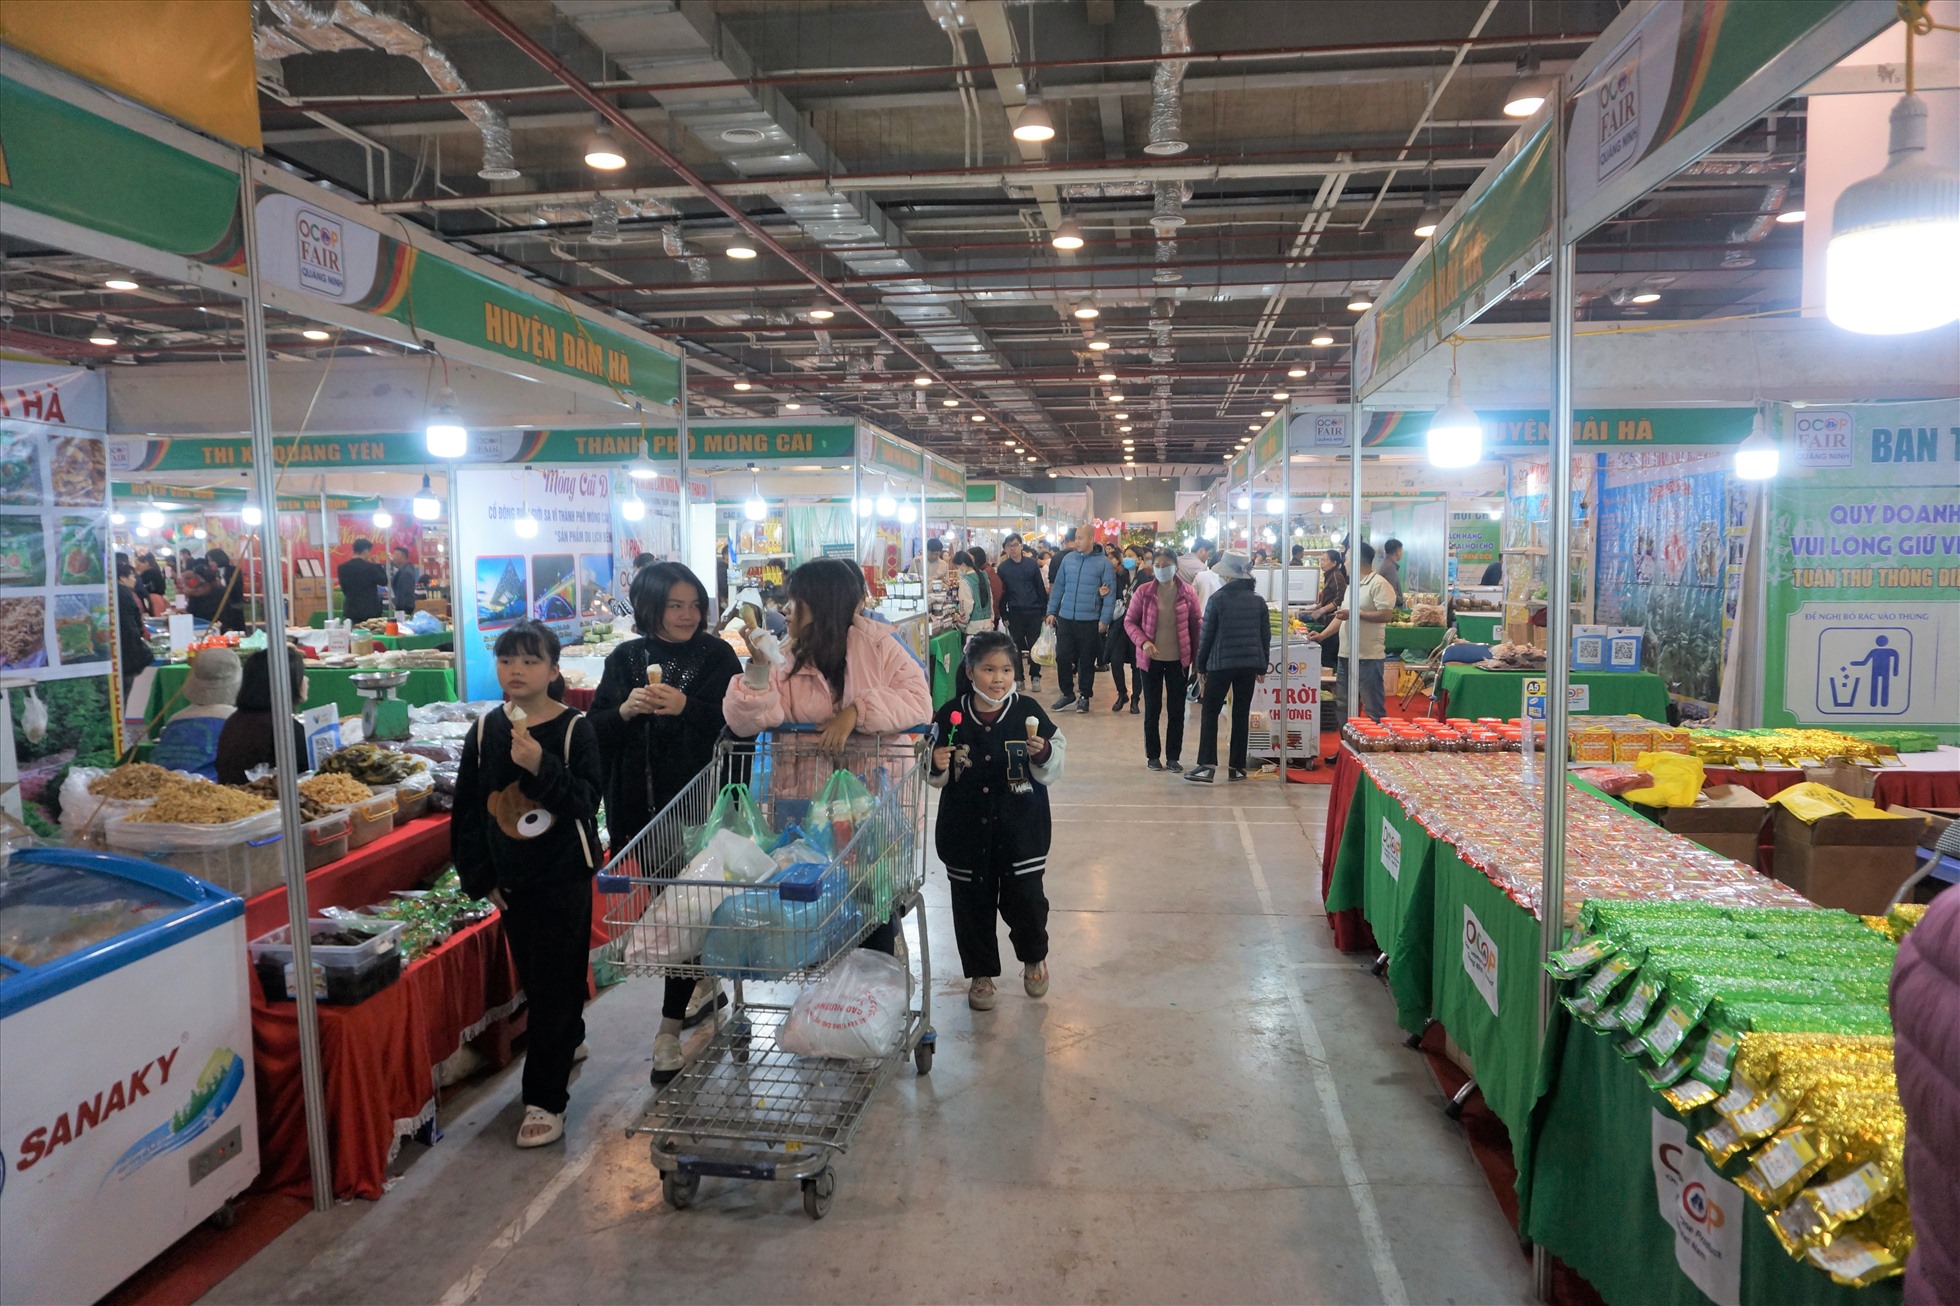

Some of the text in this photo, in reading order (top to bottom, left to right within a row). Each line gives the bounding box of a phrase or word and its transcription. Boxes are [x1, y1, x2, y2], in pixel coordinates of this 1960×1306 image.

[1601, 91, 1636, 143] FAIR
[299, 219, 338, 249] OCOP
[300, 239, 340, 272] FAIR
[327, 276, 343, 287] NINH
[484, 301, 556, 364] HUYỆN
[608, 348, 631, 385] HÀ
[17, 383, 66, 423] HÀ
[1317, 428, 1343, 436] FAIR
[1490, 417, 1549, 445] UYỆN
[1618, 417, 1654, 441] HÀ
[1798, 417, 1848, 433] OCOP
[704, 431, 768, 453] MÓNG
[776, 430, 813, 452] CÁI
[1799, 433, 1847, 448] FAIR
[1871, 427, 1939, 463] BAN
[202, 446, 234, 467] THỊ
[347, 441, 385, 460] YÊN
[1829, 452, 1850, 460] NINH
[558, 507, 575, 522] THÀNH
[1830, 503, 1877, 525] QUÝ
[1790, 536, 1825, 556] VUI
[1898, 533, 1937, 556] GIỮ
[1793, 564, 1836, 588] TUÂN
[1841, 562, 1873, 588] THỦ
[1878, 564, 1933, 588] THÔNG
[1819, 613, 1841, 621] NGHỊ
[1527, 683, 1540, 691] A5
[16, 1046, 180, 1172] SANAKY
